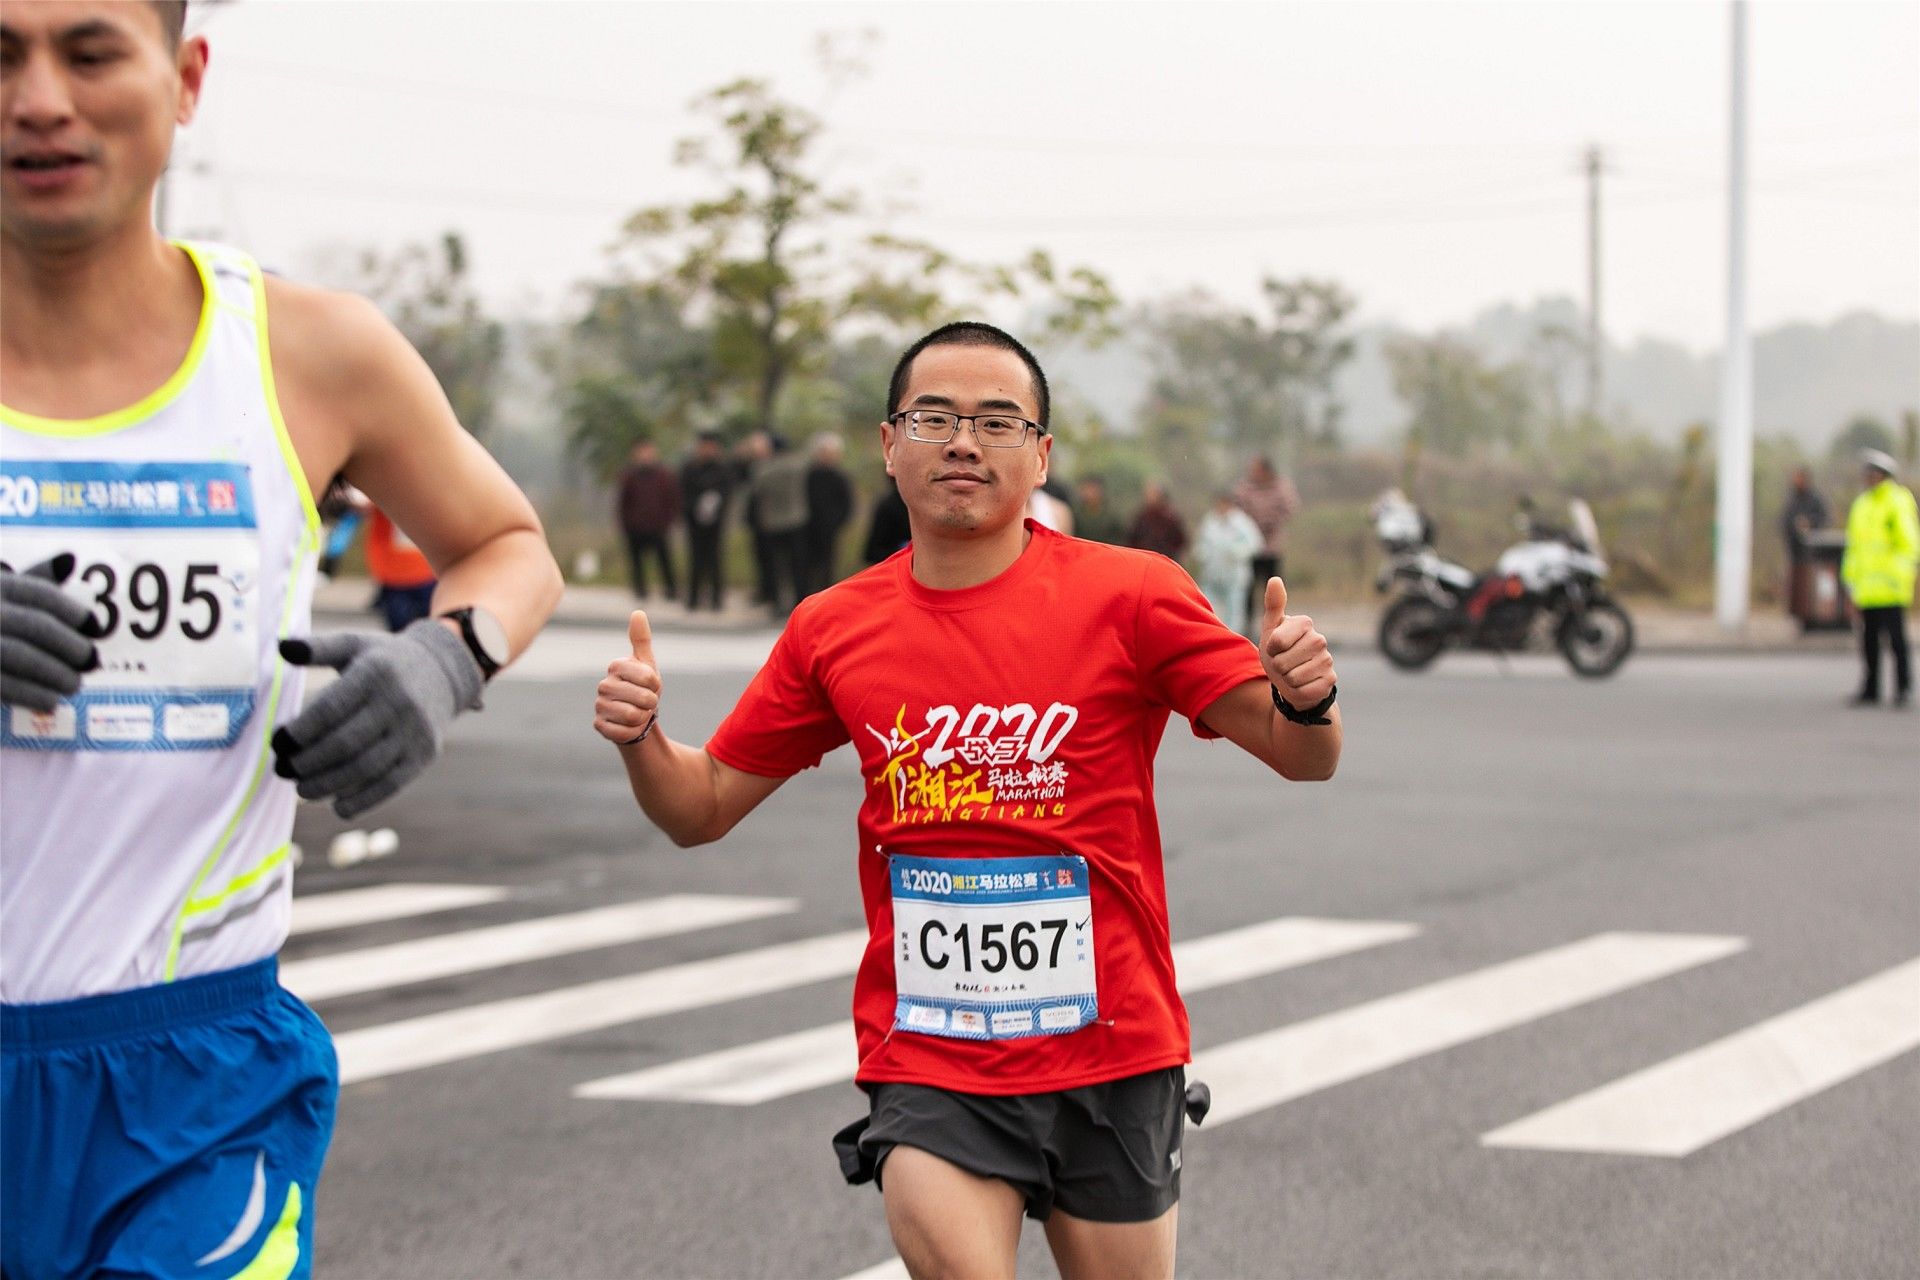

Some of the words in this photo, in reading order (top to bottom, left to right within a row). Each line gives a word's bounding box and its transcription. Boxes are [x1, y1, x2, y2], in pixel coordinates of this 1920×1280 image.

[0, 560, 221, 641] 395
[996, 785, 1065, 801] MARATHON
[919, 918, 1069, 973] C1567
